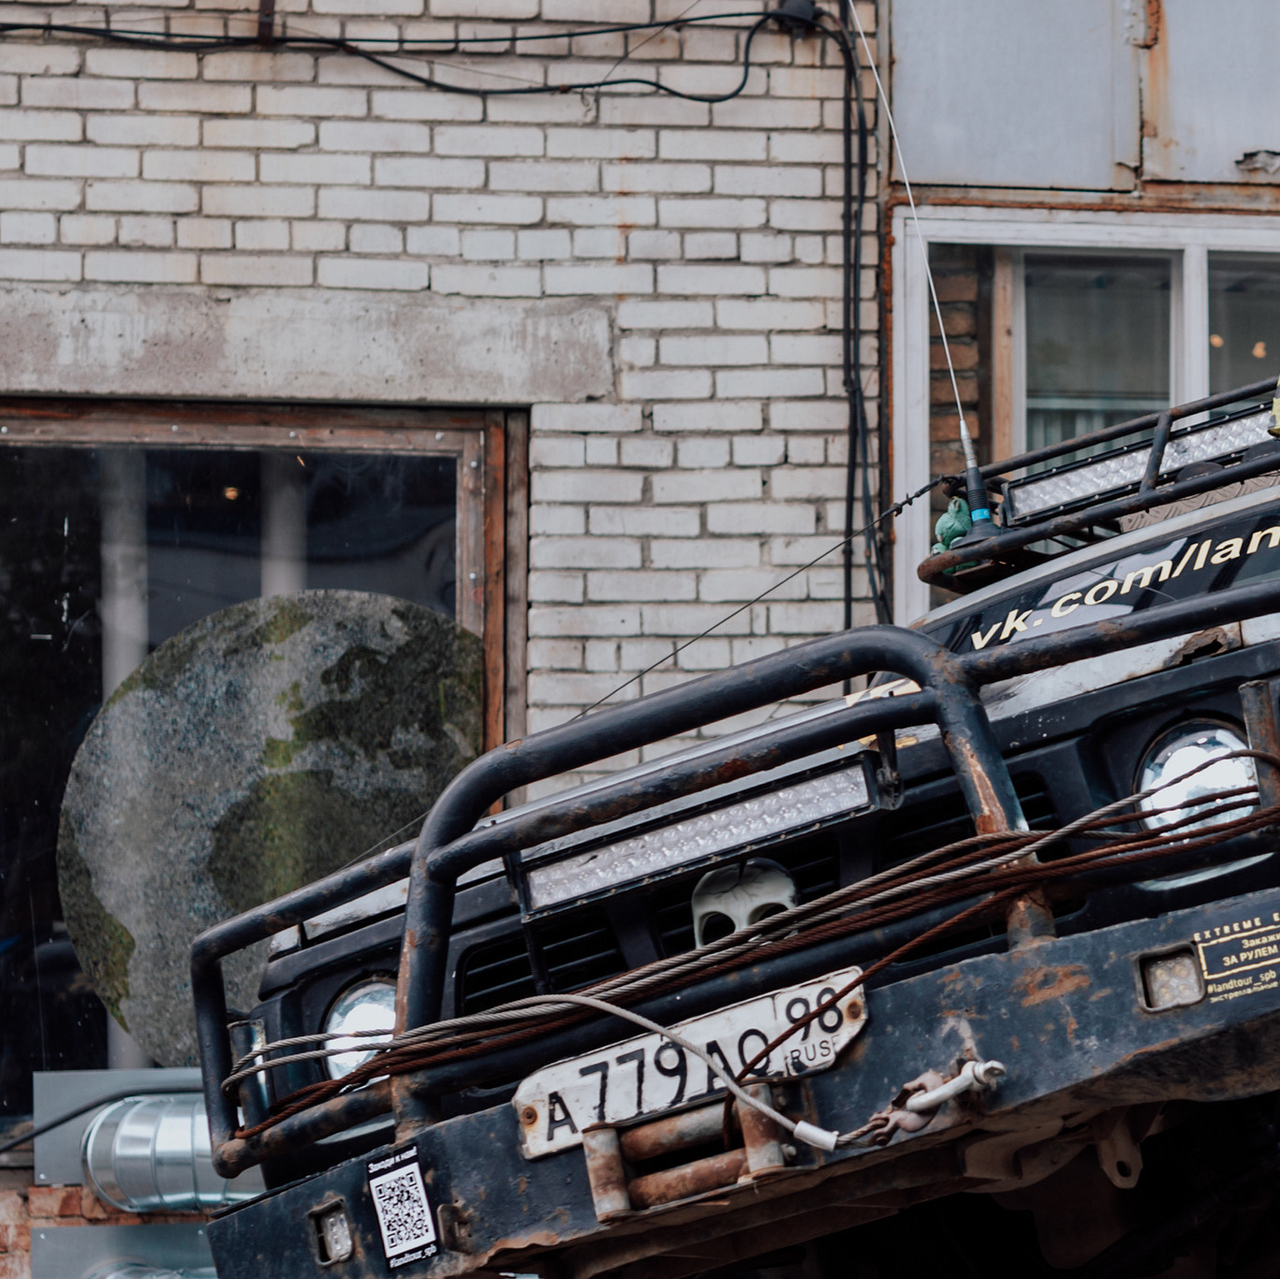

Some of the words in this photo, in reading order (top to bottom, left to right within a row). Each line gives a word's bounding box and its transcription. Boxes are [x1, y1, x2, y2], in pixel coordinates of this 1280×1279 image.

[1194, 917, 1262, 942] EXTREME
[1222, 954, 1239, 968] ЗА
[1239, 943, 1279, 964] РУЛЕМ
[1206, 969, 1277, 995] #landtour_spb
[784, 986, 844, 1042] 98
[789, 1035, 832, 1063] RUS
